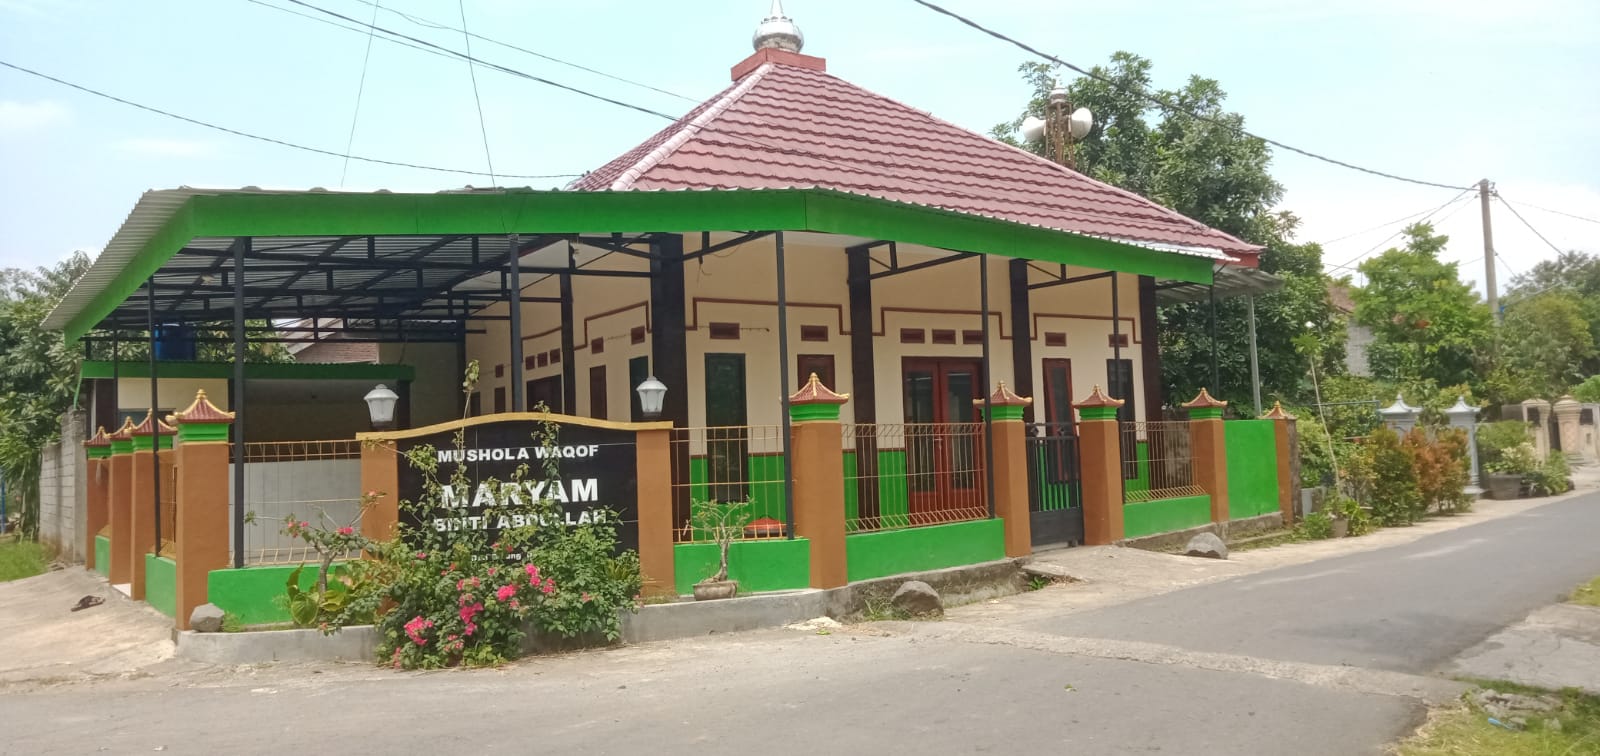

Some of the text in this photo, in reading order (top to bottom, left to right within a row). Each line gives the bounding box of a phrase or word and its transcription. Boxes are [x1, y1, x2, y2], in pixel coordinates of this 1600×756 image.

[438, 445, 599, 463] MUSHOLA WAQOF
[441, 478, 598, 508] MARYAM
